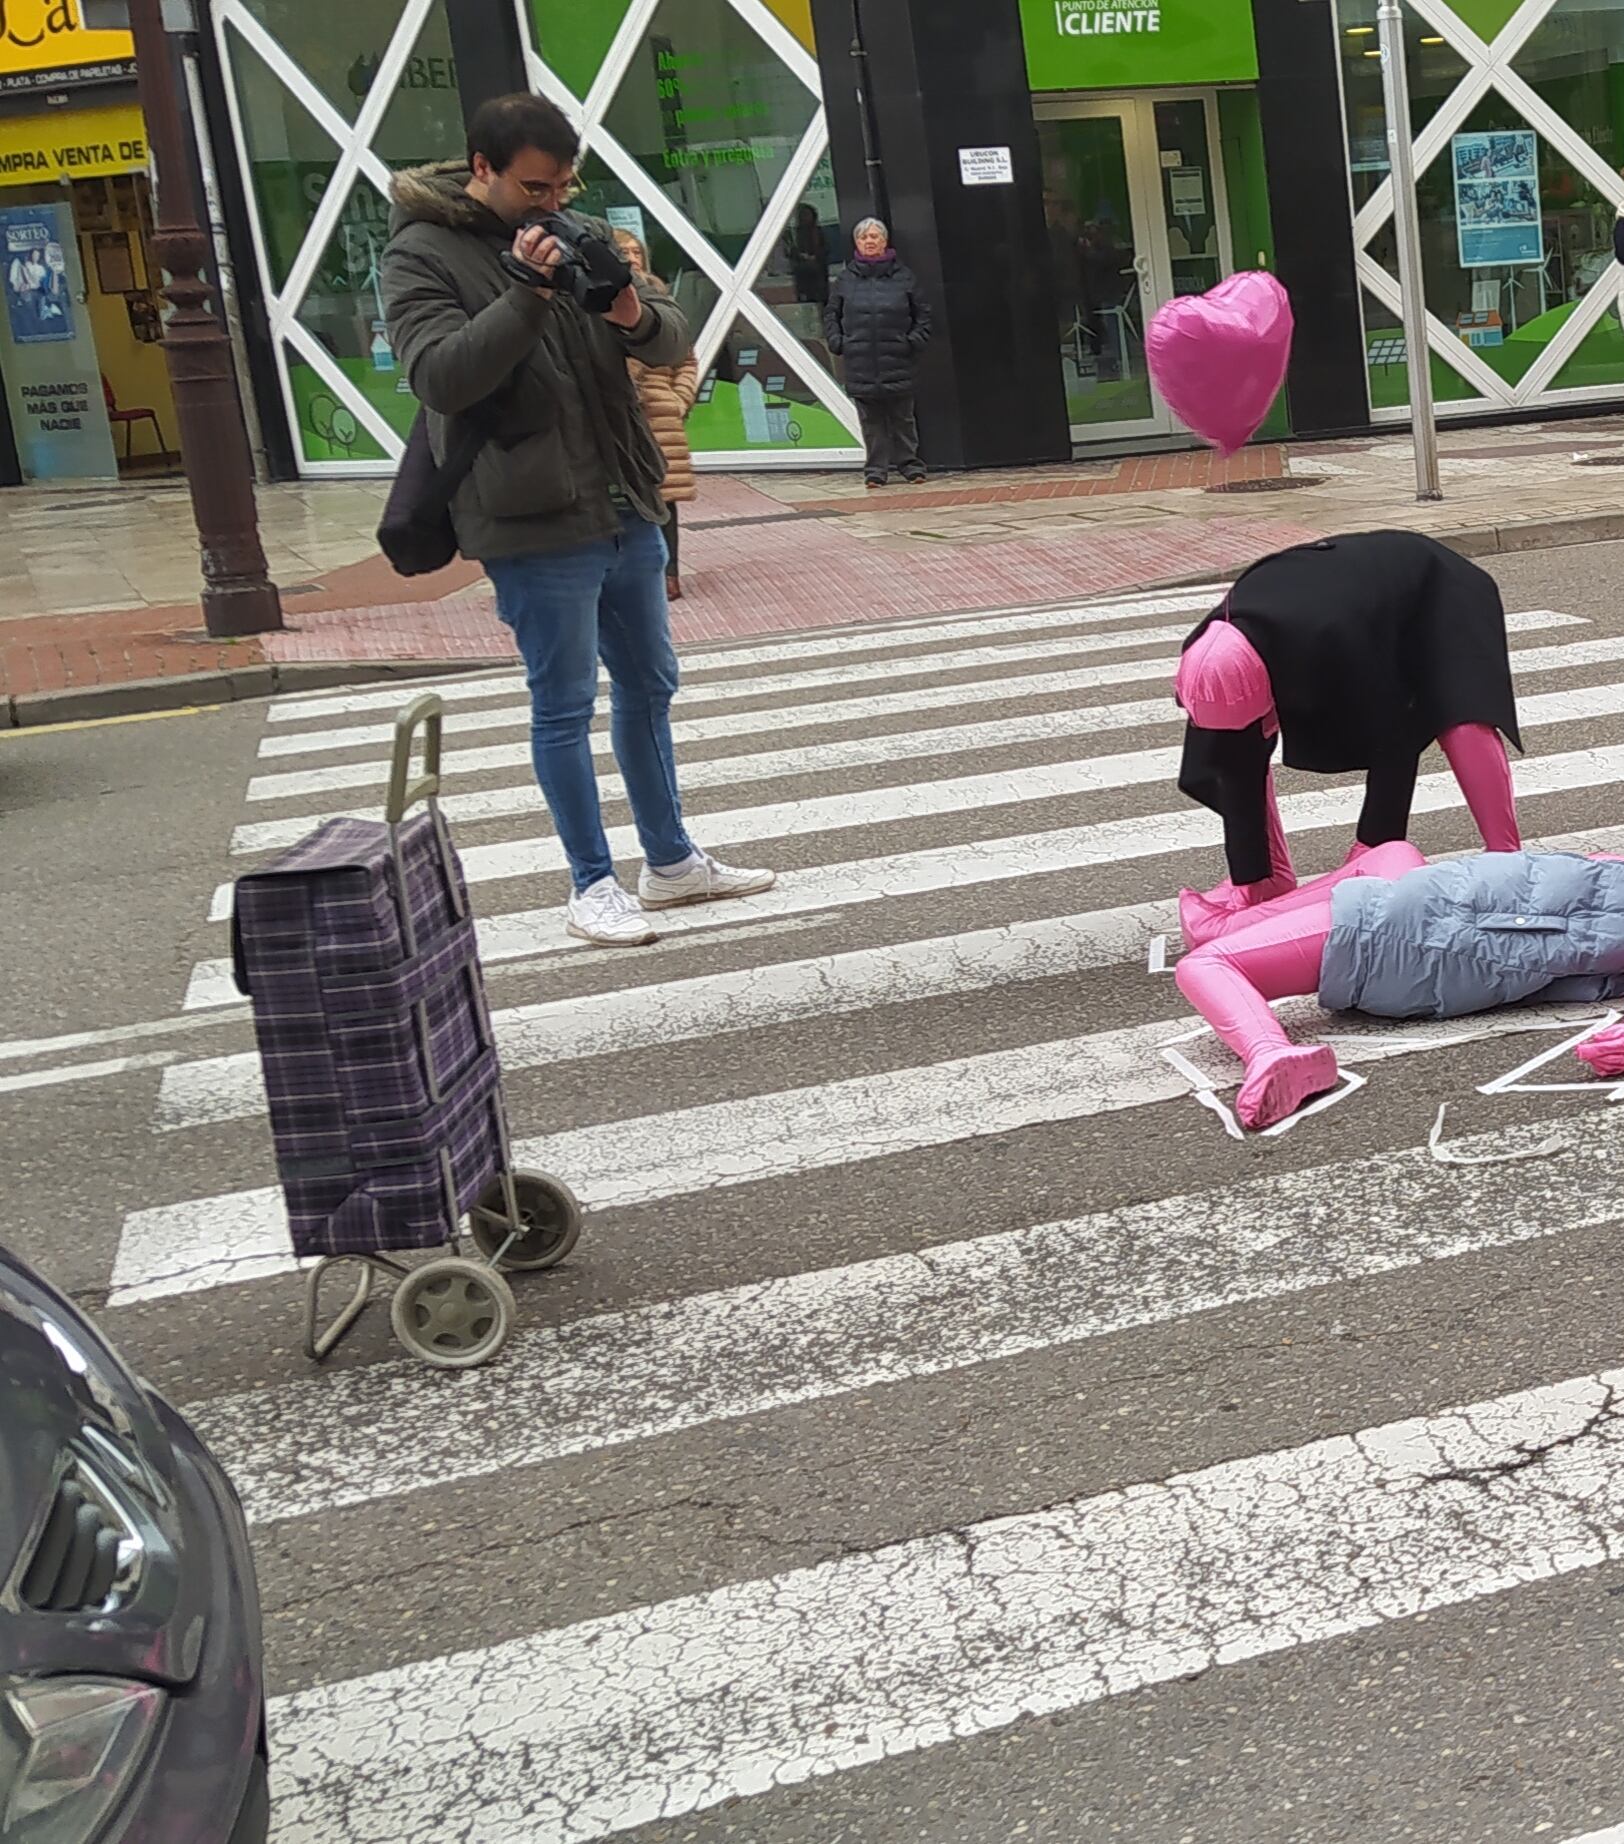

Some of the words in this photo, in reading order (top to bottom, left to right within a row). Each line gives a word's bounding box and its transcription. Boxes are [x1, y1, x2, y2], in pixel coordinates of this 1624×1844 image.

[1062, 0, 1095, 11] PUNTO
[1097, 0, 1109, 10] DE
[1064, 10, 1160, 35] CLIENTE
[52, 144, 115, 168] VENTA
[118, 140, 146, 161] DE
[20, 383, 88, 398] PAGAMOS
[61, 400, 88, 413] QUE
[40, 418, 82, 431] NADIE
